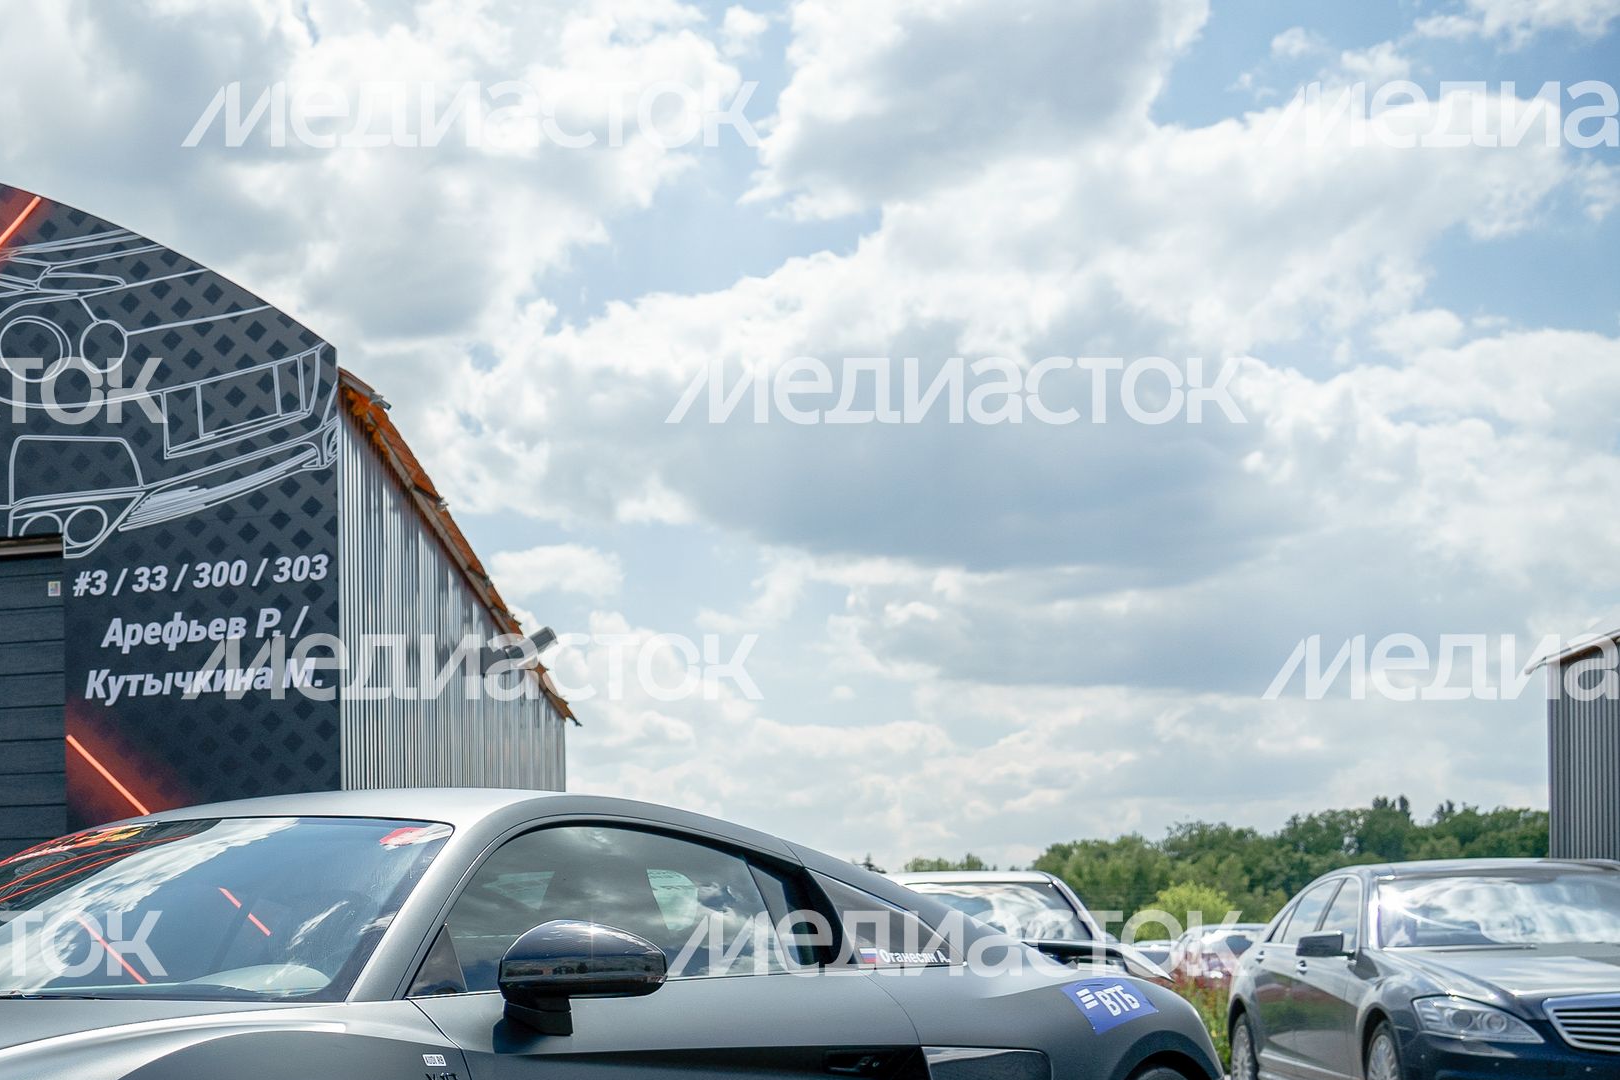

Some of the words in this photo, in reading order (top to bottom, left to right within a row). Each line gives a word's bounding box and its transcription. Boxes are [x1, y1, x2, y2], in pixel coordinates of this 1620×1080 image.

[72, 569, 108, 597] #3
[132, 565, 168, 593] 33
[192, 559, 248, 589] 300
[272, 553, 329, 583] 303
[100, 611, 247, 655] Арефьев
[84, 665, 273, 707] Кутычкина
[281, 657, 323, 689] М.
[1094, 985, 1140, 1017] ВТБ
